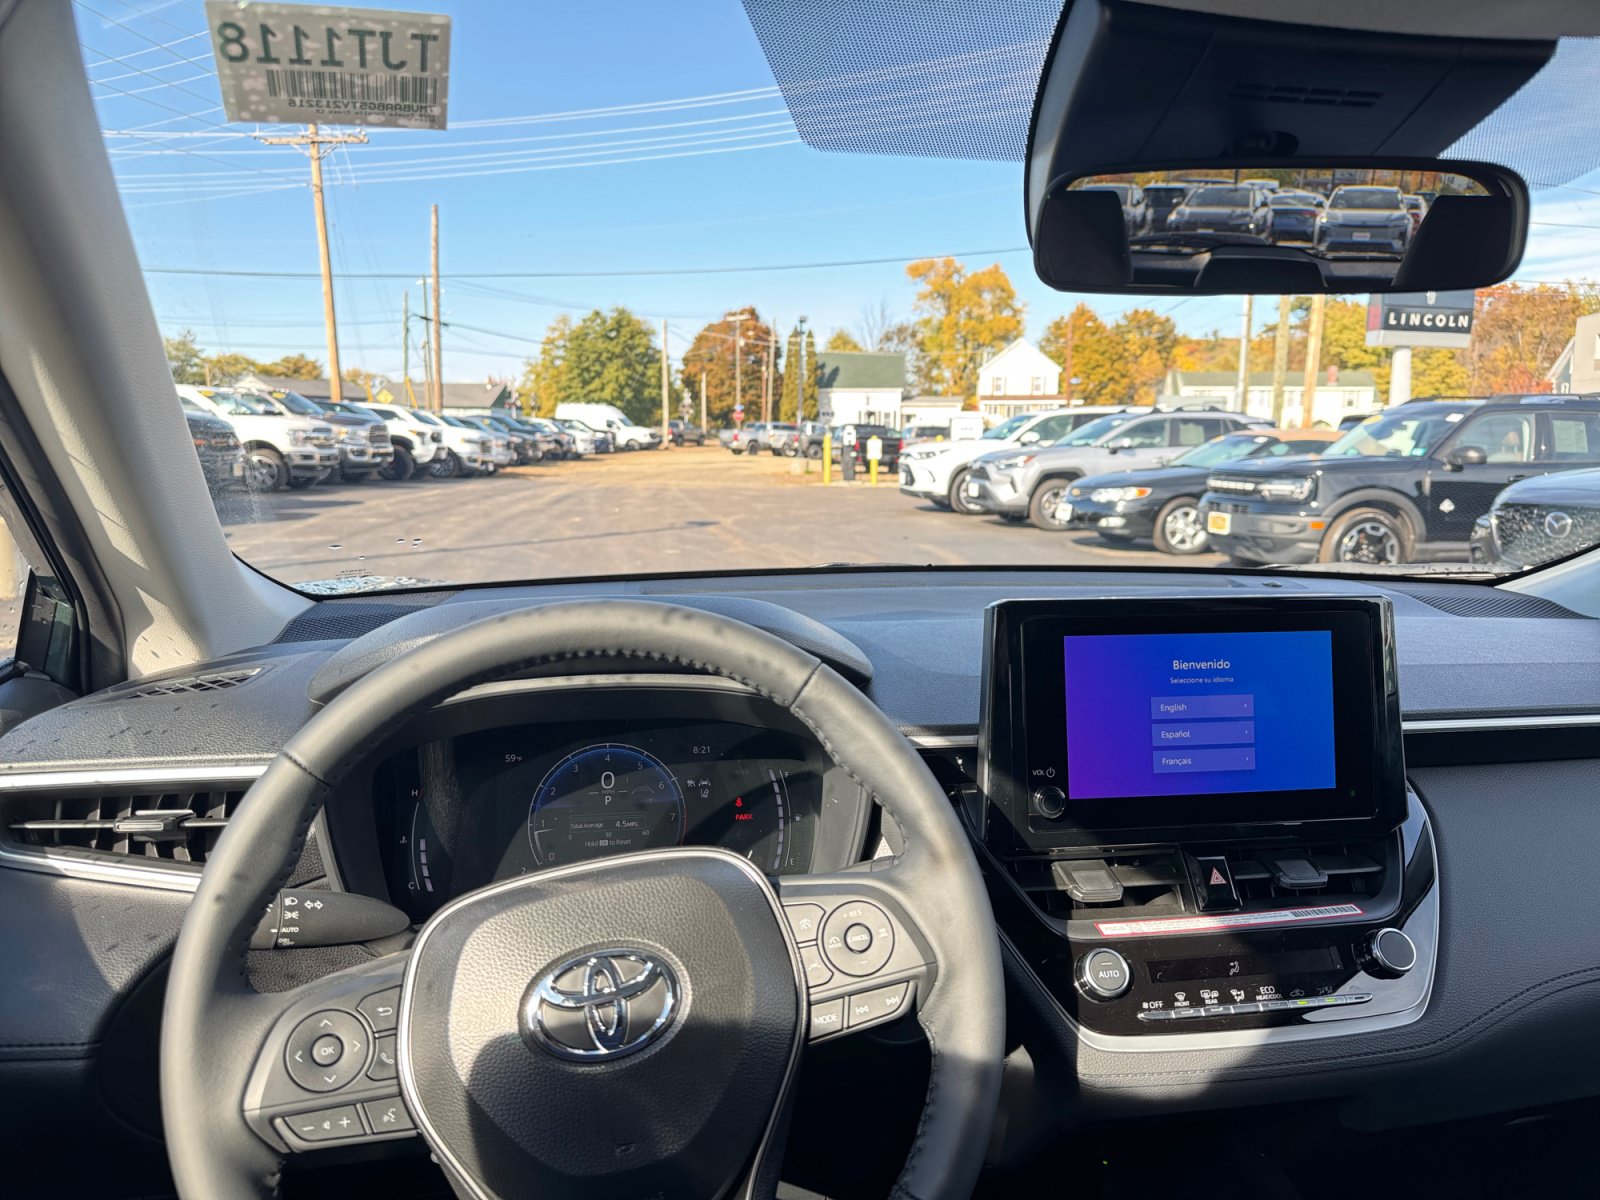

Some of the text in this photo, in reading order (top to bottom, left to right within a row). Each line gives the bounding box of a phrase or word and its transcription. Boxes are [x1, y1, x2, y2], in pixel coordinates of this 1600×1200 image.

[1388, 312, 1469, 328] LINCOLN
[1172, 658, 1230, 671] Bienvenido
[1170, 676, 1203, 685] Seleccione
[1212, 675, 1234, 684] idioma
[1160, 703, 1187, 713] English
[1161, 729, 1190, 740] Español
[692, 746, 711, 754] 8:21
[604, 754, 610, 762] 4
[1162, 756, 1192, 767] Français
[573, 765, 579, 773] 3
[637, 761, 643, 770] 5
[1032, 769, 1045, 777] VOL
[658, 782, 665, 790] 6
[411, 789, 418, 797] H
[550, 787, 556, 795] 2
[605, 795, 612, 805] P
[670, 812, 676, 821] 7
[736, 813, 753, 821] PARK
[408, 881, 415, 890] C
[1098, 969, 1120, 979] AUTO
[1260, 986, 1275, 994] ECO
[1149, 1001, 1164, 1009] OFF
[814, 1013, 838, 1025] MODE
[321, 1046, 335, 1056] OK
